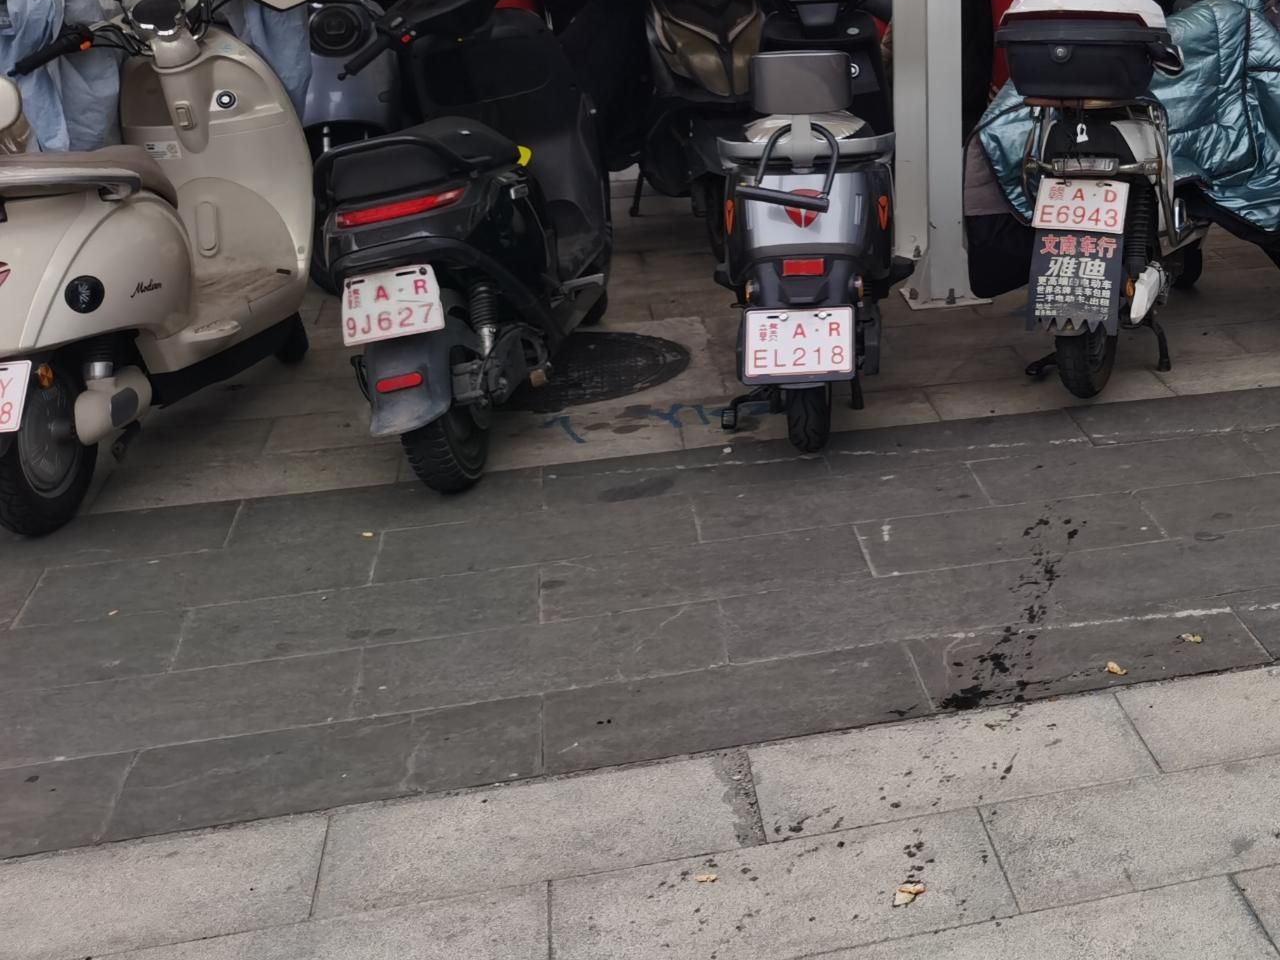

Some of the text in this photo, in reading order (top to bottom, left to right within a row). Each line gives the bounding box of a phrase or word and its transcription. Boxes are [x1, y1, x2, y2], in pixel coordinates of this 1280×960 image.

[1040, 204, 1119, 228] E6943
[1045, 256, 1106, 280] 雅迪
[346, 302, 434, 338] 9J627
[753, 345, 844, 368] EL218
